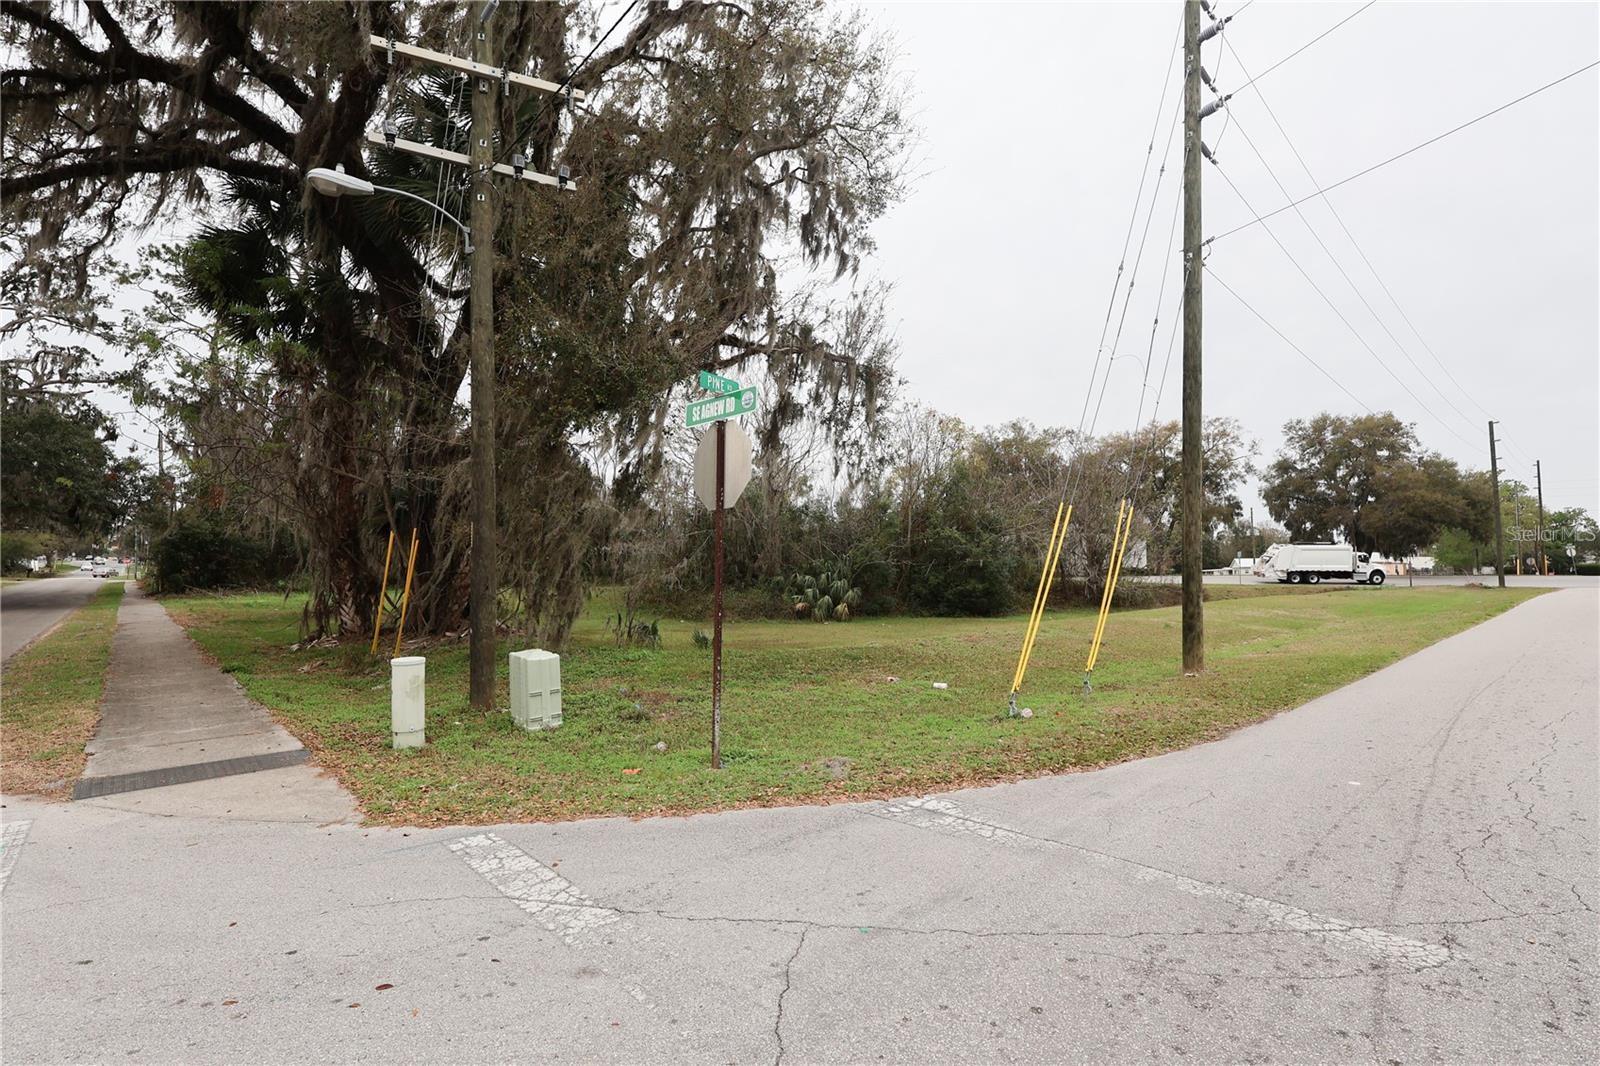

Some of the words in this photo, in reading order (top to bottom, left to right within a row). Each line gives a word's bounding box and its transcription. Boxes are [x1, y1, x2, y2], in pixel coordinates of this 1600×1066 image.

[707, 375, 725, 392] PINE
[692, 406, 701, 422] SE
[701, 399, 725, 420] AGNEW
[725, 396, 736, 413] RD
